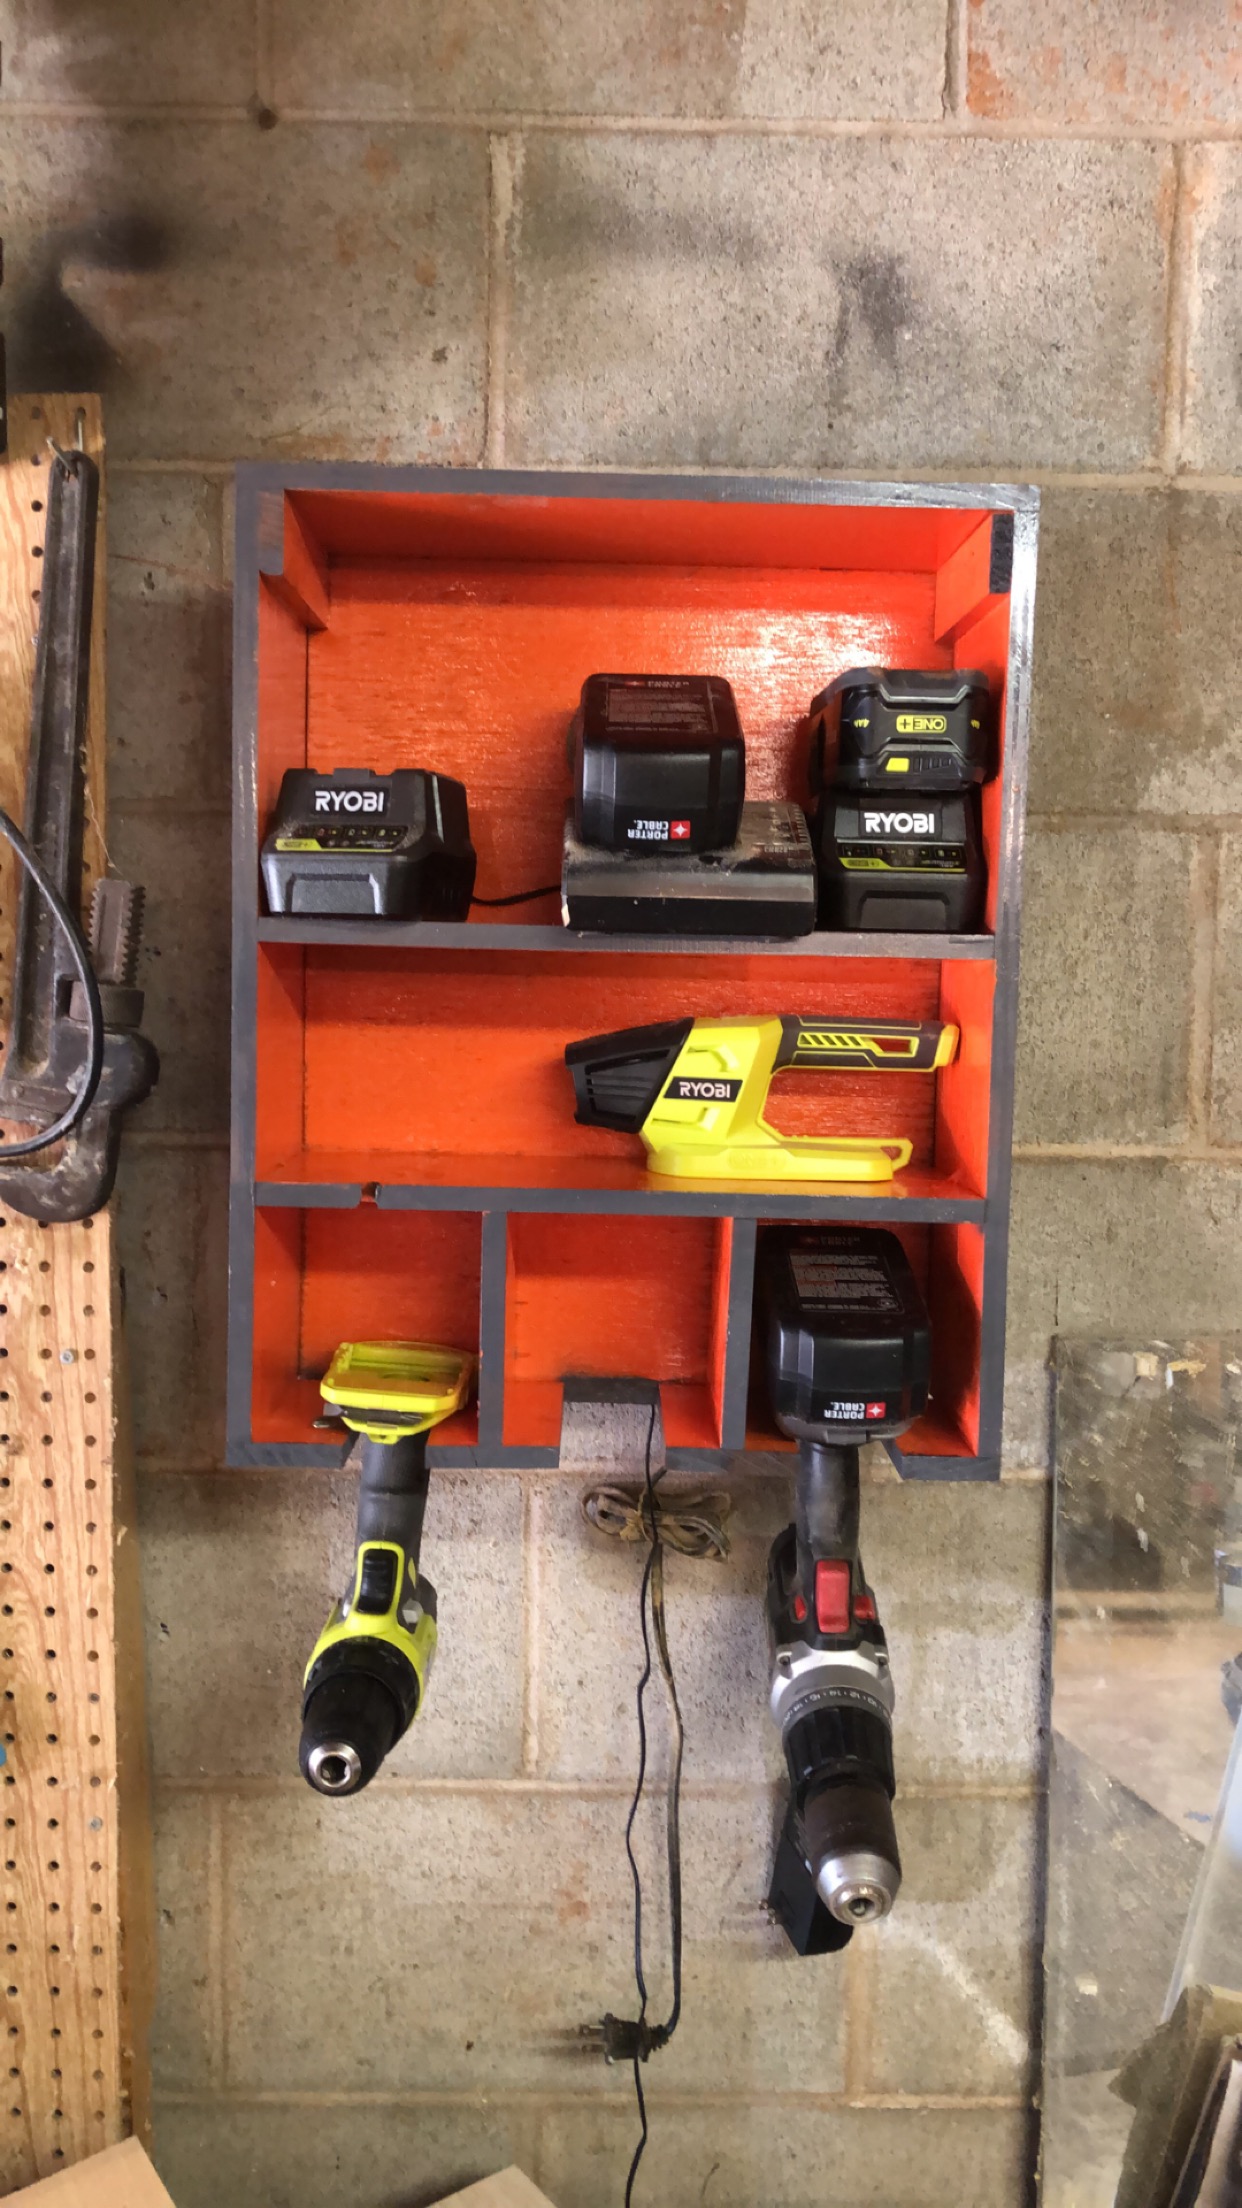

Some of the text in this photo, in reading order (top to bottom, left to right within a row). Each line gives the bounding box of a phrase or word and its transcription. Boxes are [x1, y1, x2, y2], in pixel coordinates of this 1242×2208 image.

[314, 790, 385, 812] RYOBI
[863, 812, 935, 833] RYOBI
[627, 829, 669, 840] PORTER
[678, 1081, 731, 1099] RYOBI
[823, 1410, 865, 1420] PORTER
